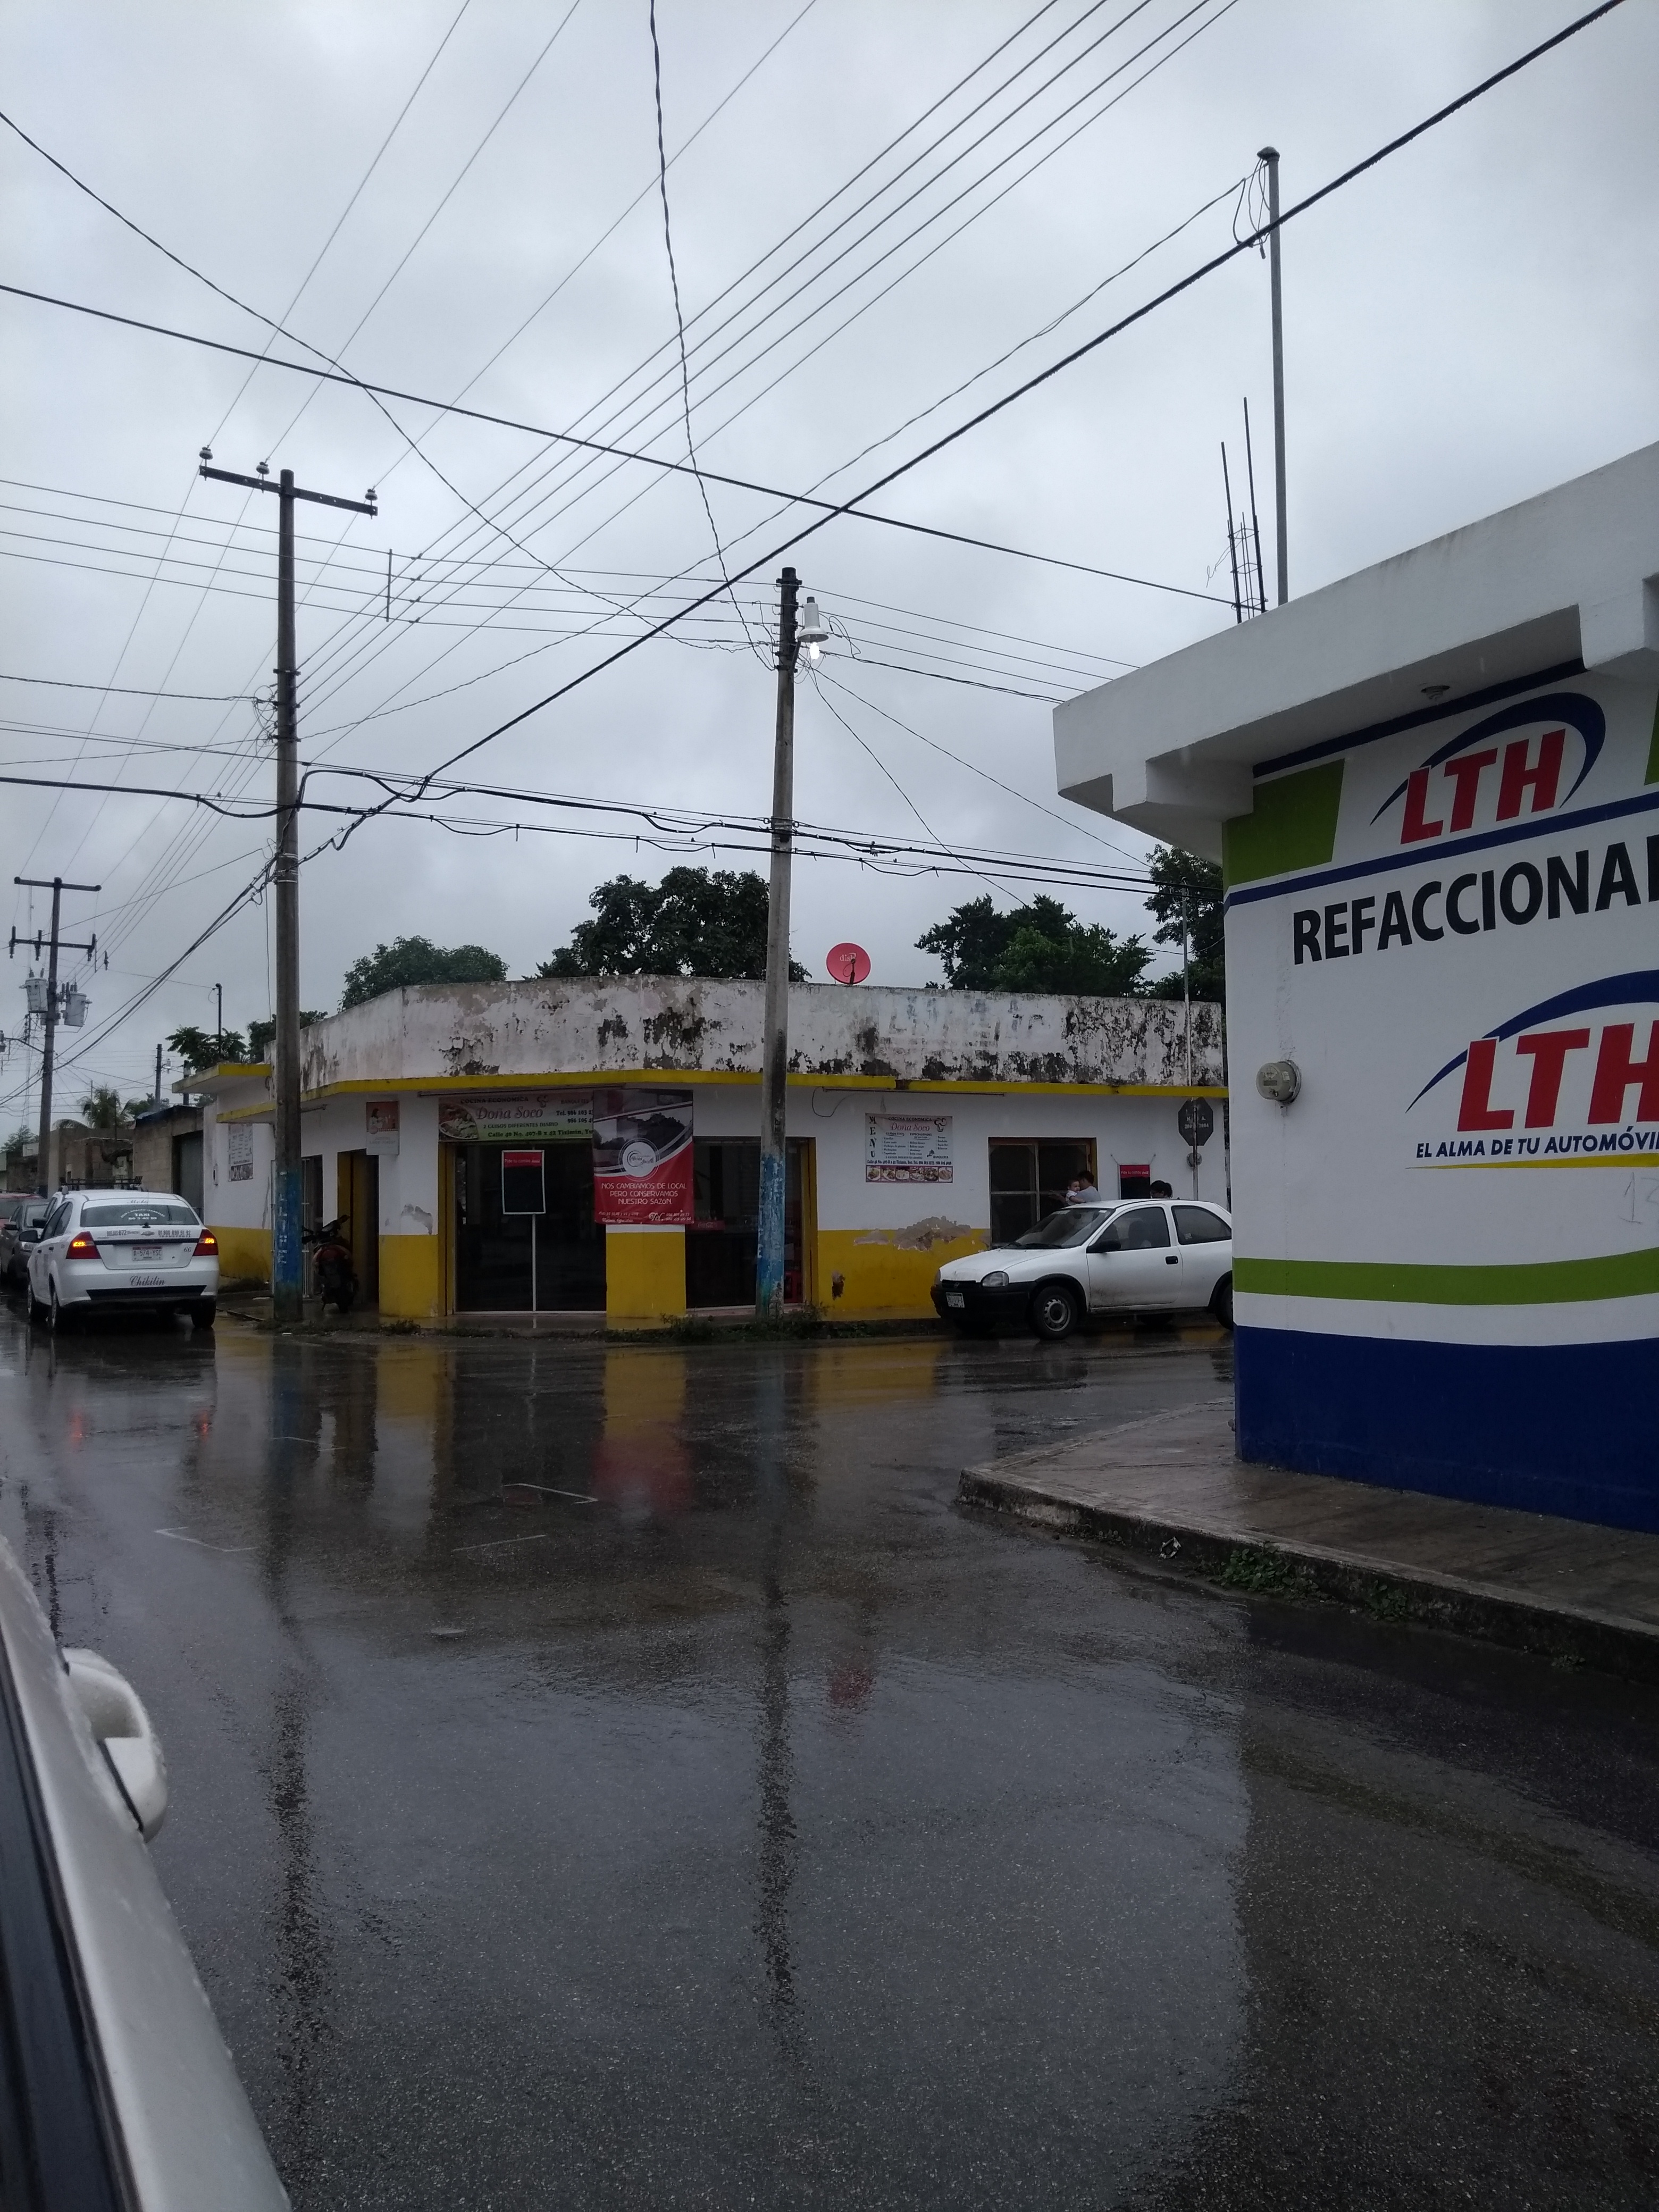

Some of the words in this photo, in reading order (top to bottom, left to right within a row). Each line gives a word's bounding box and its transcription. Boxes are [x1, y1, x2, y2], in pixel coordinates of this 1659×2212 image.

[1401, 728, 1565, 844] LTH
[1457, 1019, 1659, 1132] LTH
[476, 1107, 512, 1119] Doña
[515, 1105, 543, 1118] Soco
[914, 1123, 930, 1132] Soco
[1416, 1143, 1432, 1158] EL
[1436, 1140, 1485, 1158] ALMA
[1491, 1138, 1514, 1155] DE
[1518, 1137, 1540, 1155] TU
